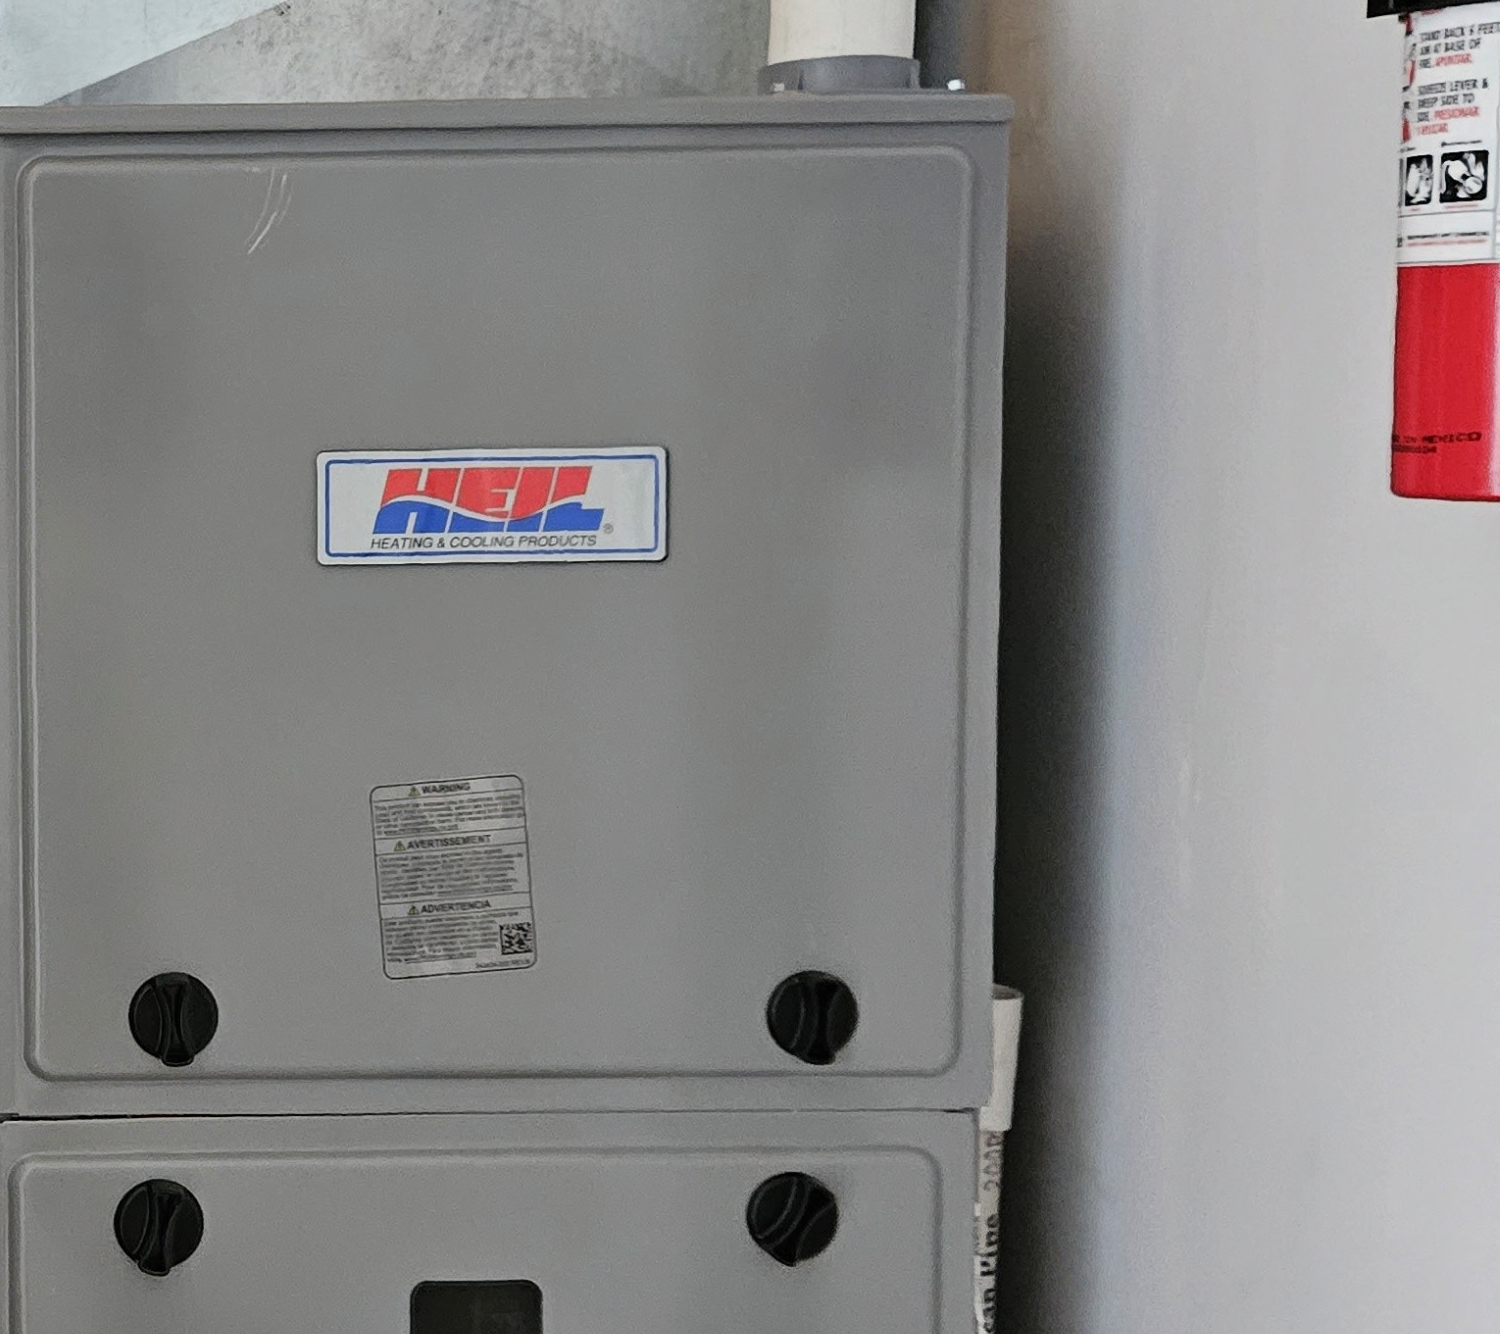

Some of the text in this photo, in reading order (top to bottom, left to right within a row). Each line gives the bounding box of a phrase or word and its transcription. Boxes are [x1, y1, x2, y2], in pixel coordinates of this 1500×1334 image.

[372, 466, 605, 535] HEIL
[370, 534, 598, 550] HEATING & COOLING PRODUCTS
